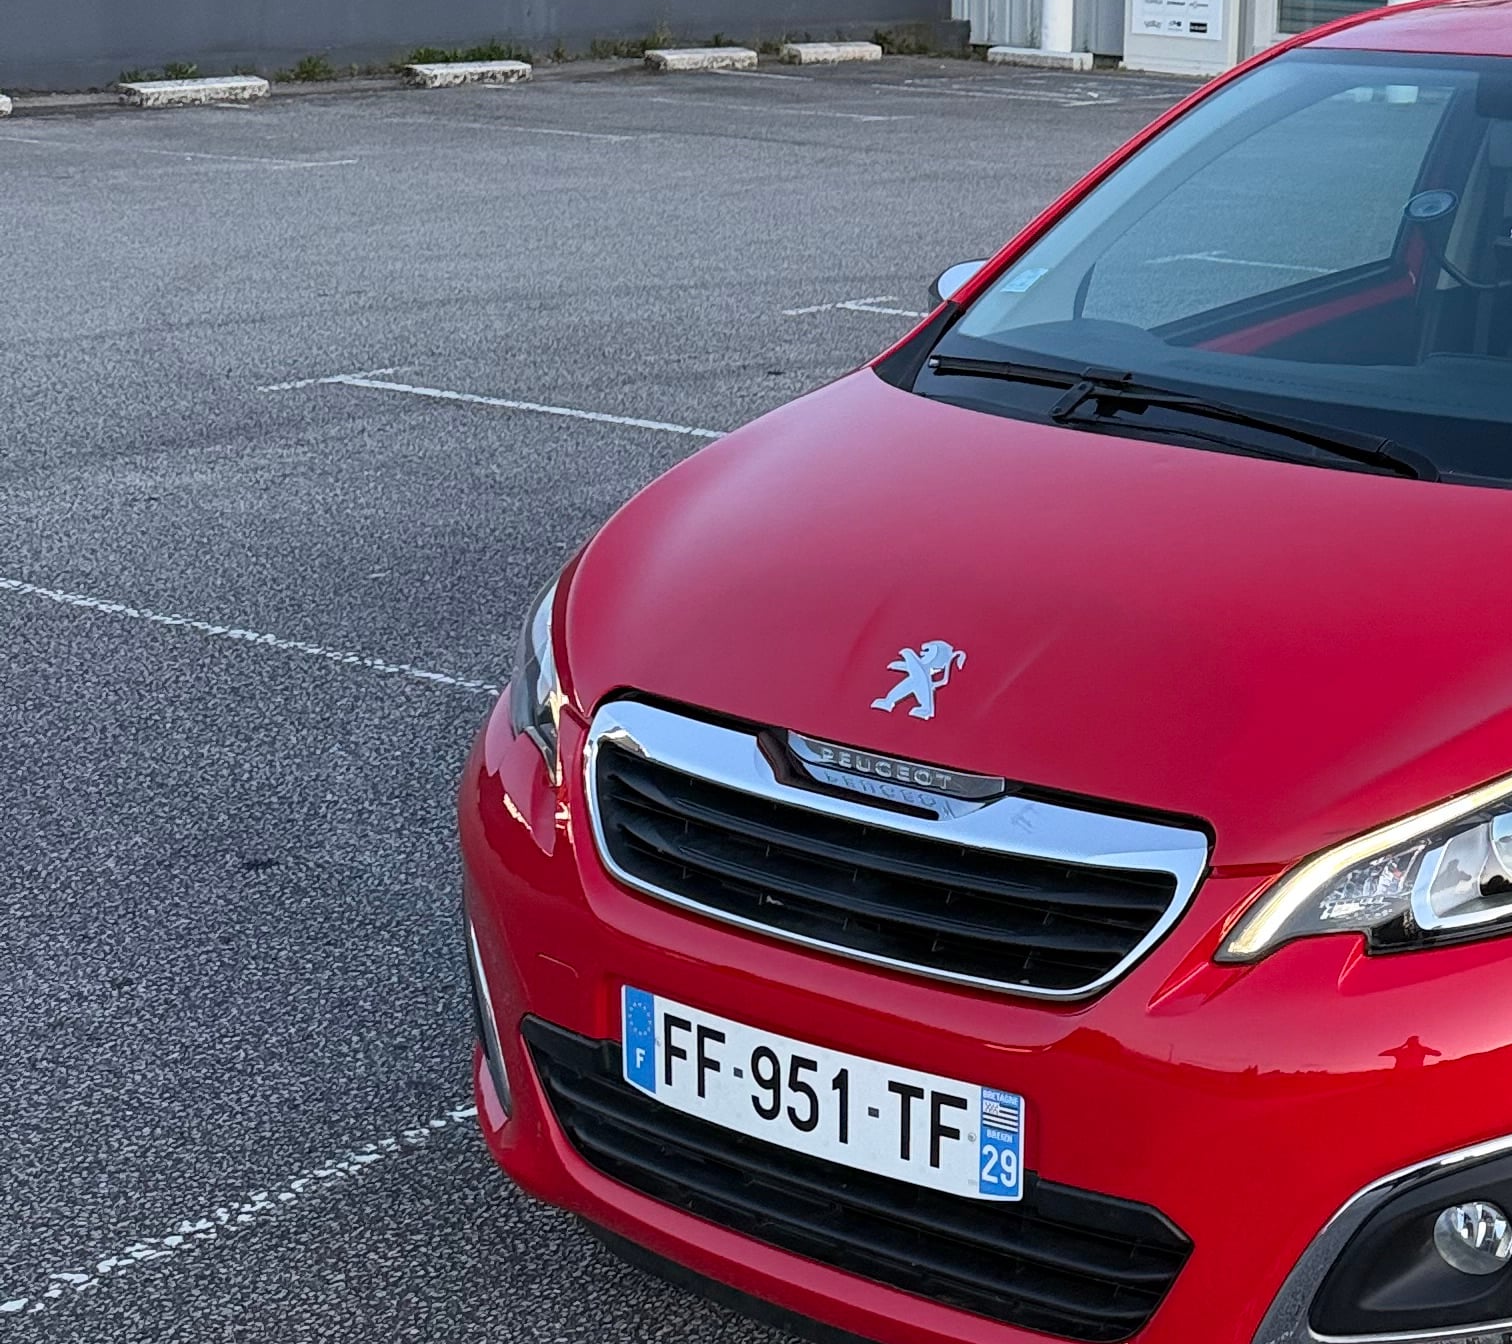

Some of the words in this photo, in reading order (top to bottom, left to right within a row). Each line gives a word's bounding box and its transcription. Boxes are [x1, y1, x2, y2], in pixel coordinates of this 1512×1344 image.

[820, 747, 952, 791] PEUGEOT
[635, 1047, 646, 1069] F
[663, 1011, 968, 1170] FF-951-TF
[981, 1144, 1018, 1188] 29
